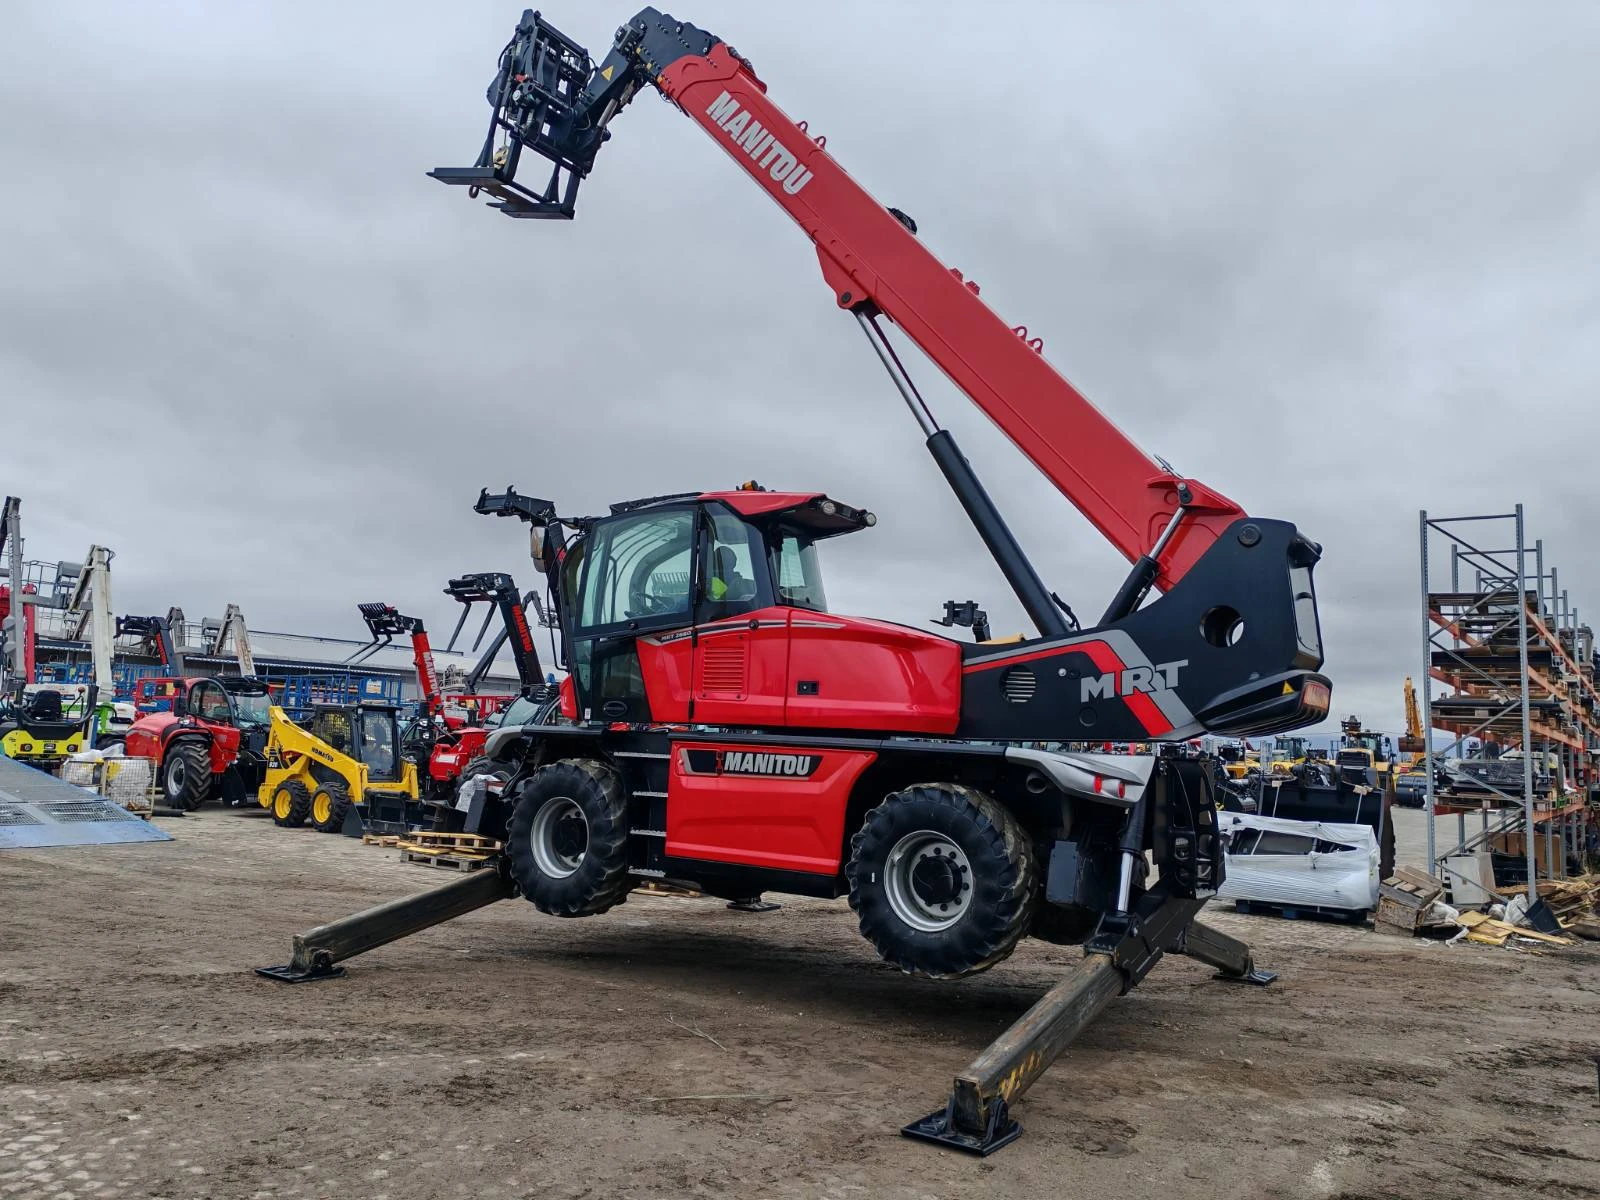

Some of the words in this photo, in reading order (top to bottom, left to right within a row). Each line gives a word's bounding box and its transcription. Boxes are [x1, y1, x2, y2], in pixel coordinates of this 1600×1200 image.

[705, 90, 814, 194] MANITOU
[1081, 659, 1188, 703] MRT
[723, 751, 811, 776] MANITOU
